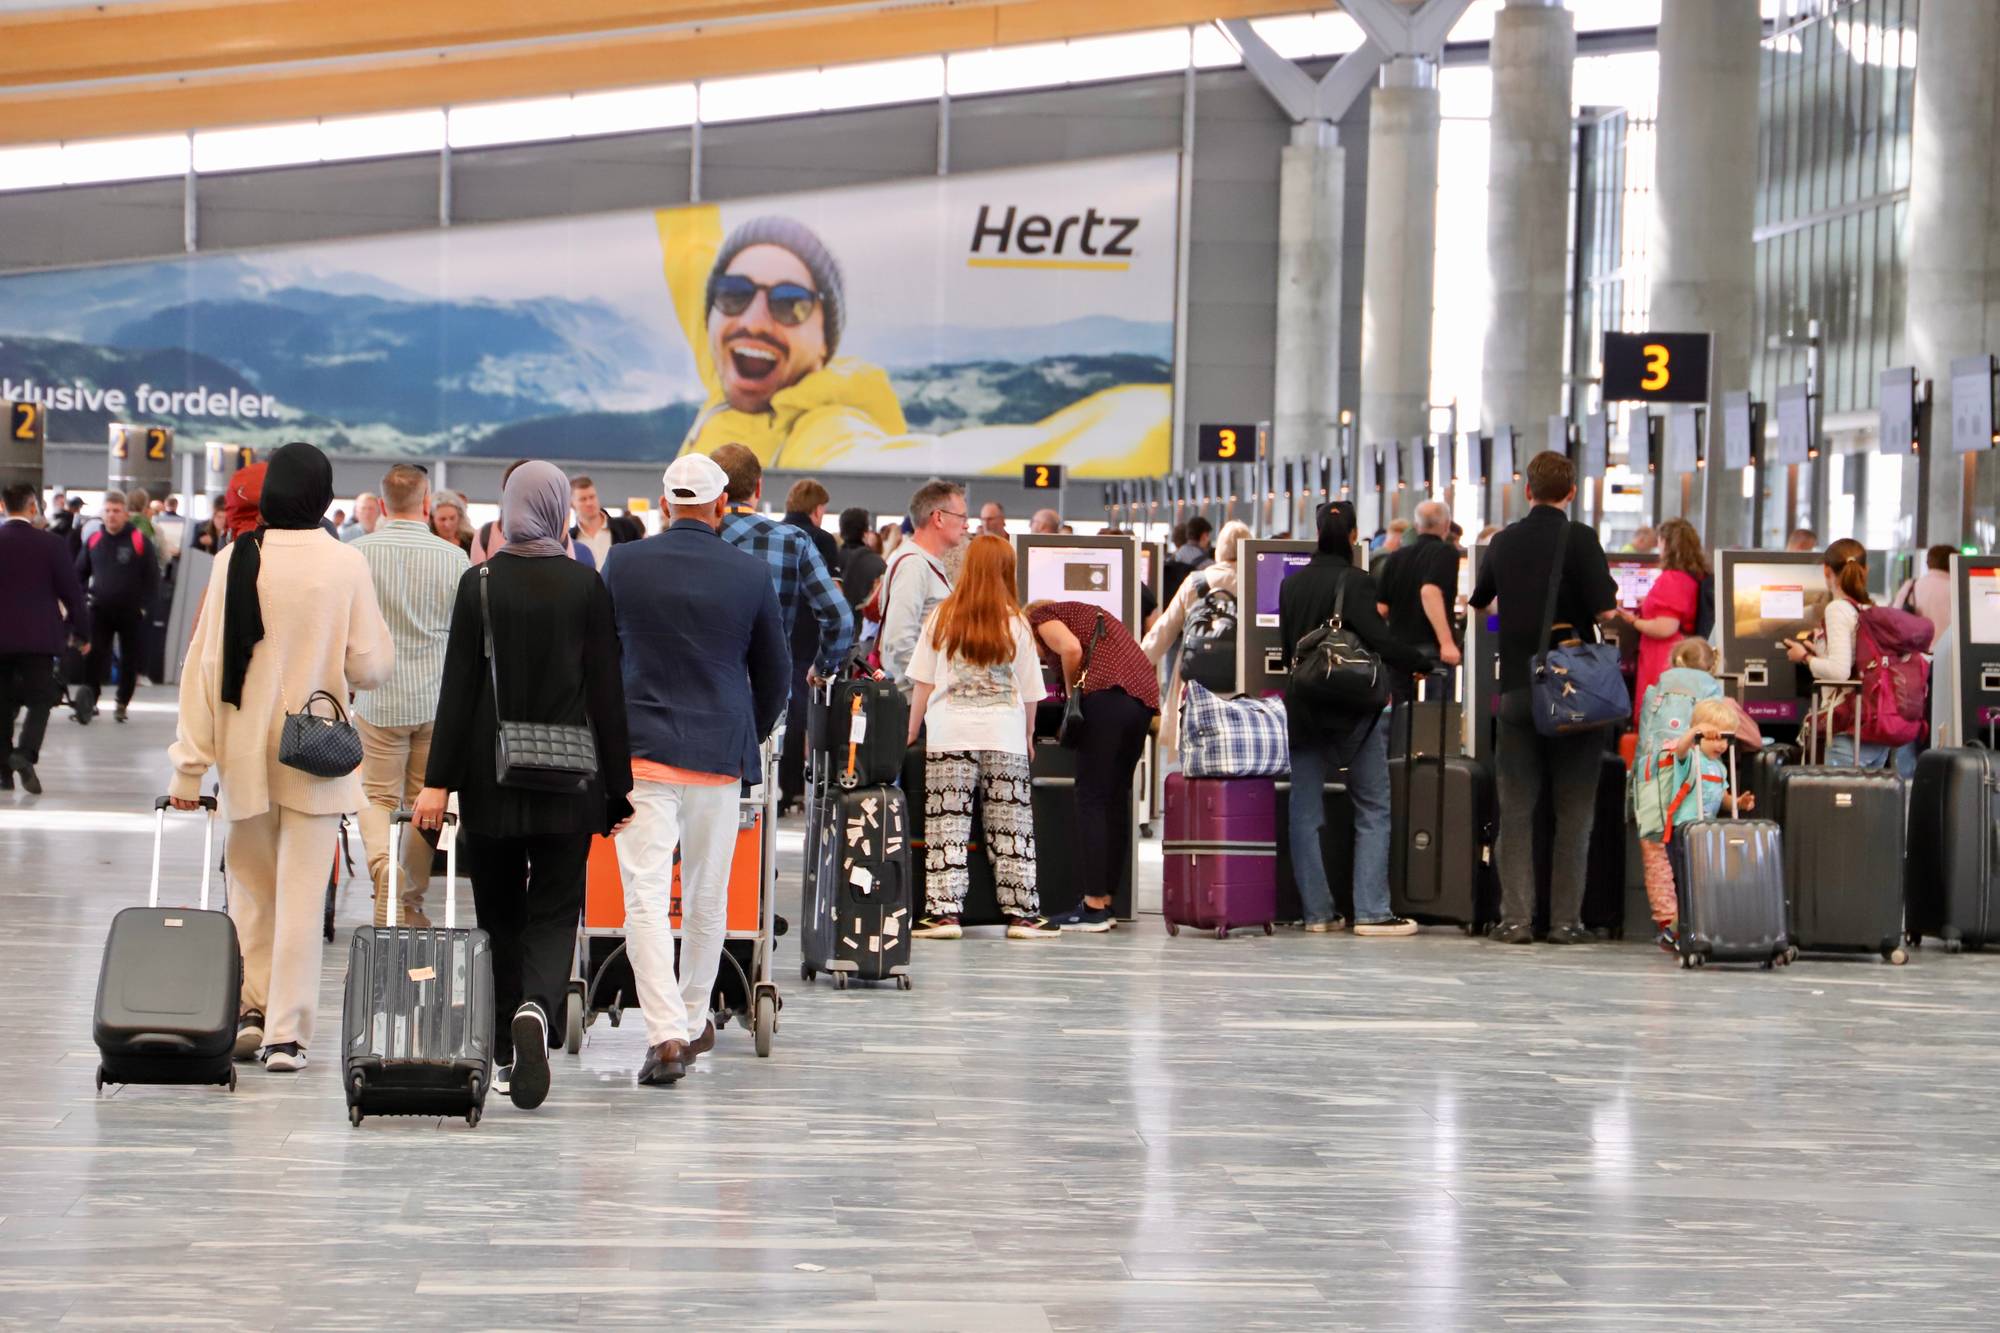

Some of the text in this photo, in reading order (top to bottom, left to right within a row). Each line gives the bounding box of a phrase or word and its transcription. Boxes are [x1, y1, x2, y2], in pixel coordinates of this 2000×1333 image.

[970, 205, 1140, 256] Hertz
[1641, 344, 1670, 390] 3
[0, 378, 280, 418] klusive fordeler.
[16, 404, 35, 439] 2
[149, 431, 165, 459] 2
[1218, 429, 1237, 458] 3
[1035, 466, 1049, 487] 2
